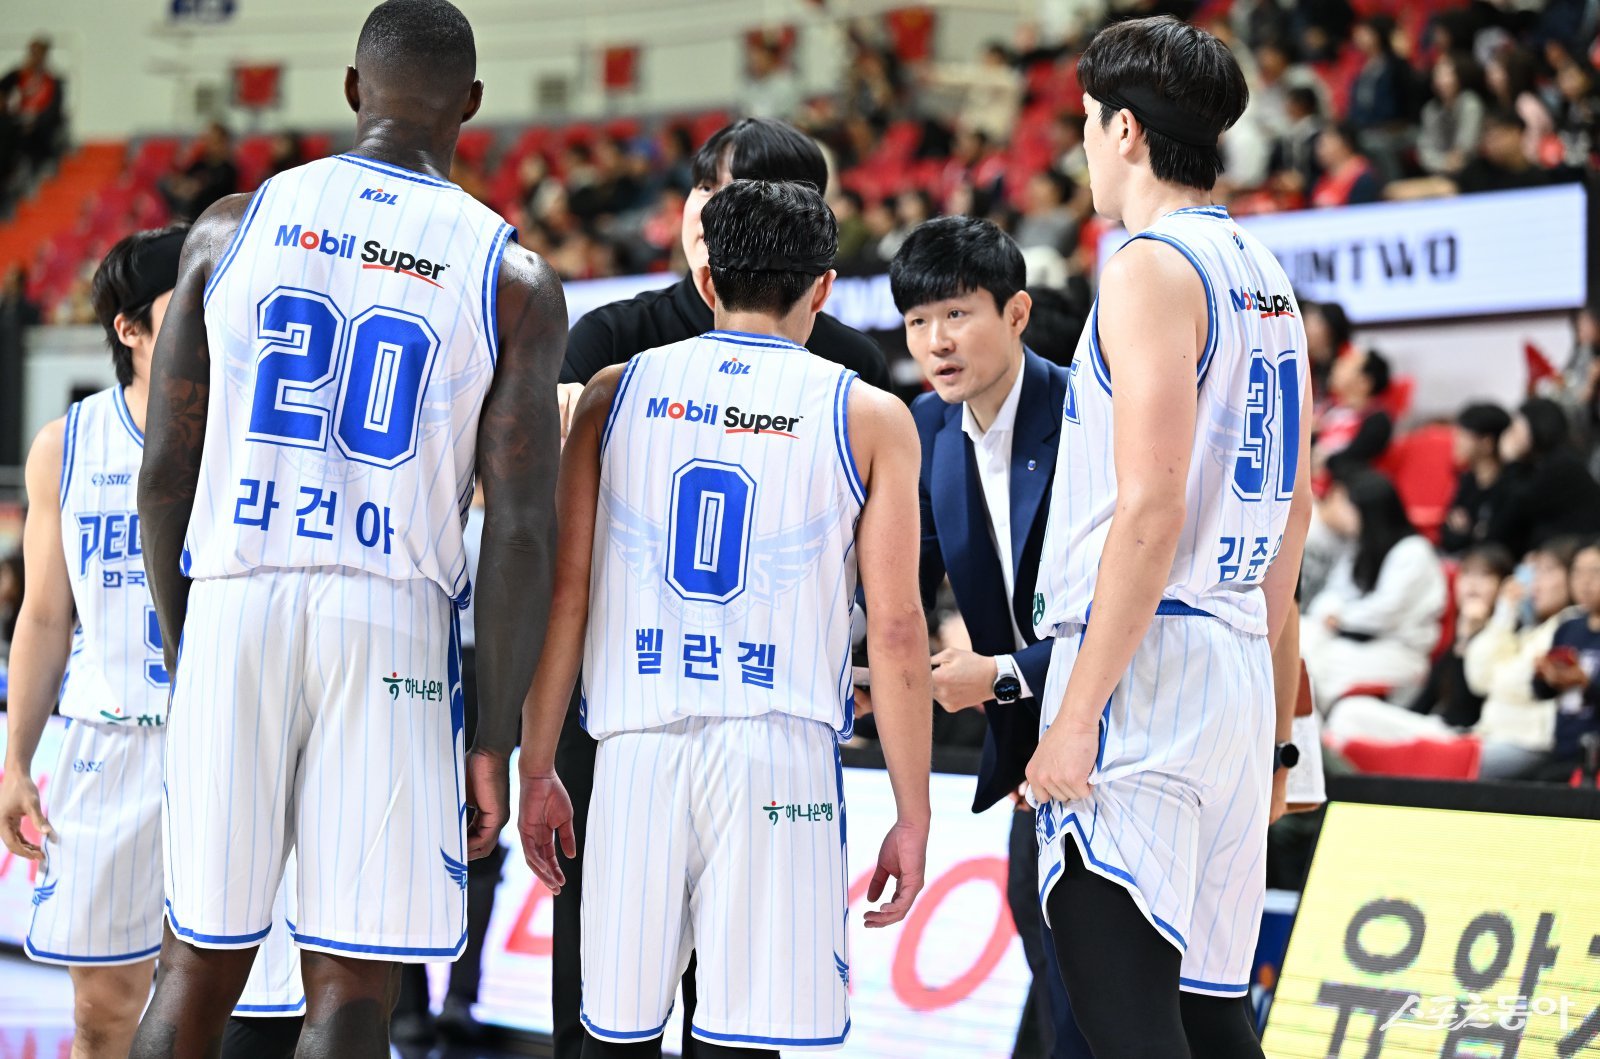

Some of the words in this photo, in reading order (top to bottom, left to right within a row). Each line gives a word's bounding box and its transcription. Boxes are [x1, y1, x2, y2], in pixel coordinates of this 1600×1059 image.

[359, 187, 399, 206] KBL
[275, 224, 356, 260] Mobil
[361, 240, 446, 281] Super
[245, 285, 442, 471] 20
[718, 357, 751, 375] KBL
[646, 397, 719, 426] Mobil
[724, 406, 800, 435] Super
[1231, 349, 1300, 502] 31
[233, 477, 395, 555] 라건아
[665, 457, 758, 606] 0
[635, 628, 776, 690] 벨란겔
[785, 802, 834, 823] 하나은행
